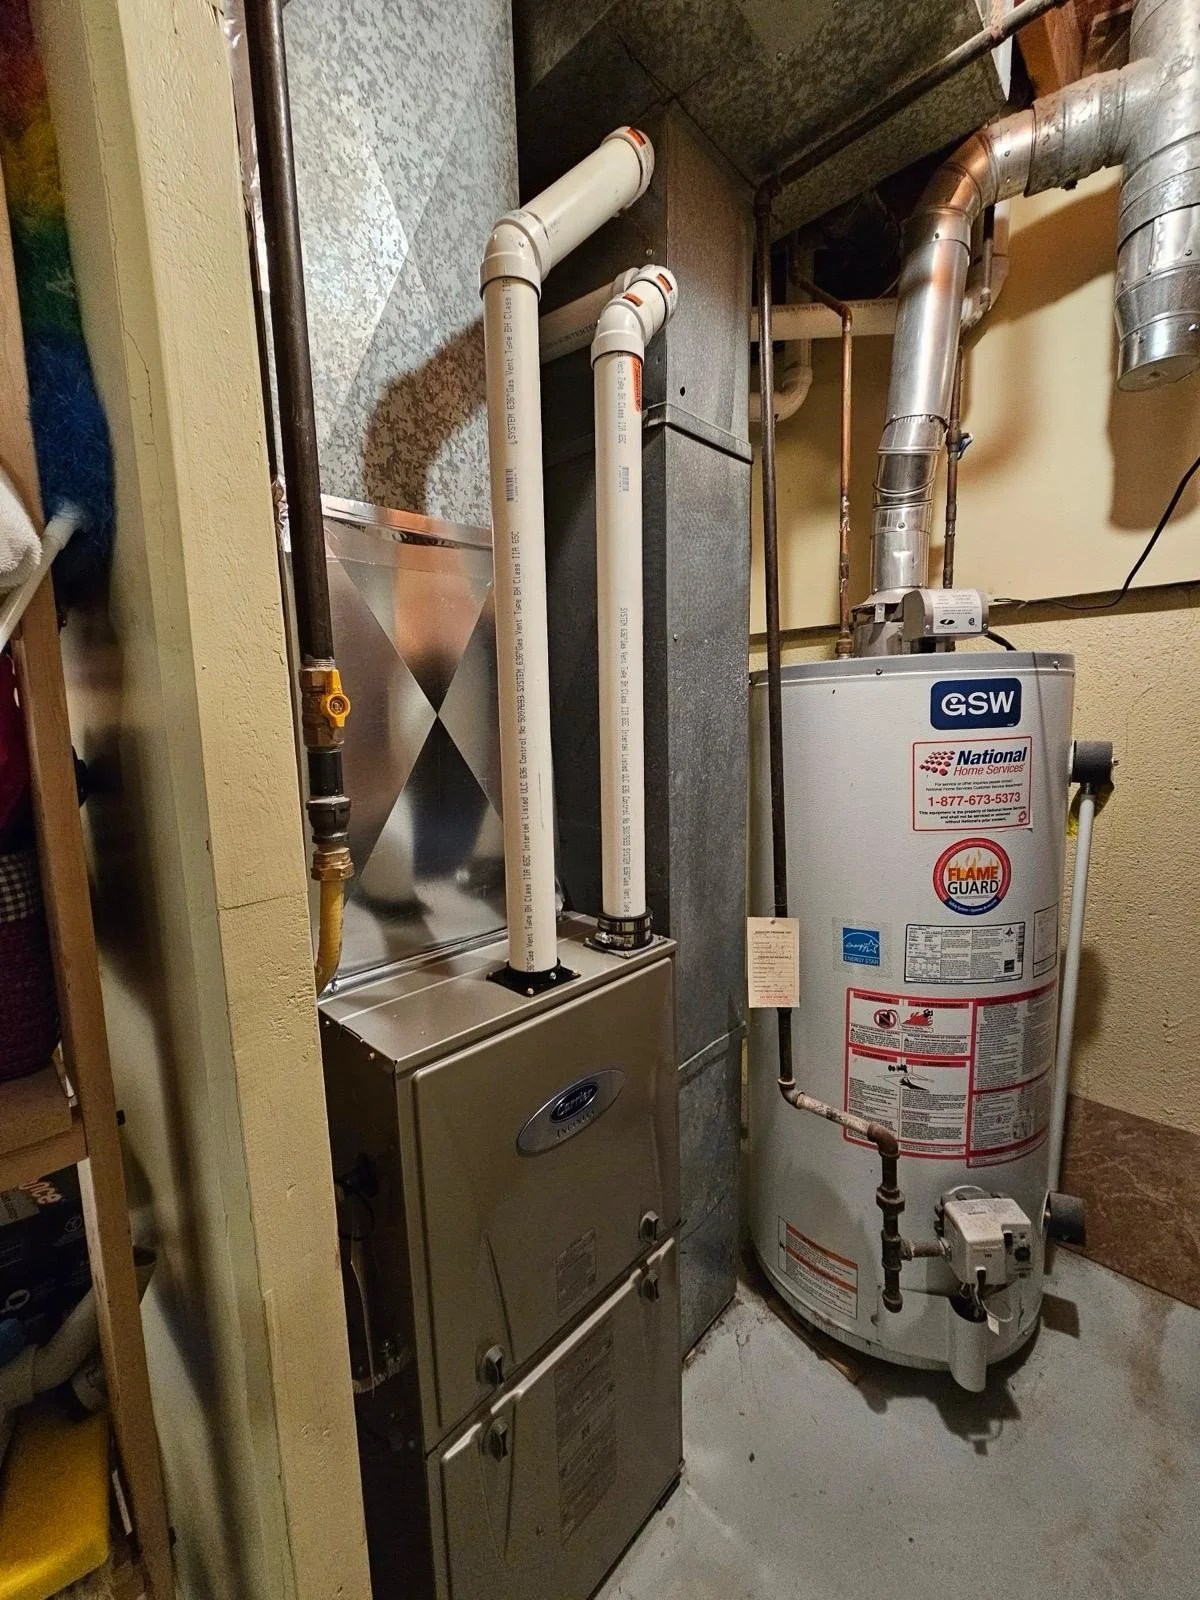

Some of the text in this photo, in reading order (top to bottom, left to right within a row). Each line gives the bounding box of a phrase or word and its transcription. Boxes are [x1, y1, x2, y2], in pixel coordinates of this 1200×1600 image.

[503, 297, 512, 320] Class
[504, 336, 513, 354] Type
[505, 358, 514, 375] Vent
[506, 413, 517, 440] SYSTEM
[512, 563, 521, 584] Class
[513, 599, 522, 615] Type
[514, 620, 523, 635] Vent
[516, 668, 525, 692] SYSTEM
[941, 690, 1014, 716] GSW
[518, 738, 527, 764] Control
[956, 746, 1028, 766] National
[519, 767, 528, 779] 636
[953, 763, 1025, 777] Home Services
[520, 782, 528, 793] ULC
[928, 792, 1021, 807] 1-877-673-5373
[520, 797, 529, 820] Listed
[522, 823, 531, 851] Intertek
[948, 865, 999, 881] FLAME
[523, 883, 532, 902] Class
[947, 880, 999, 895] GUARD
[524, 915, 533, 930] Type
[525, 933, 534, 948] Vent
